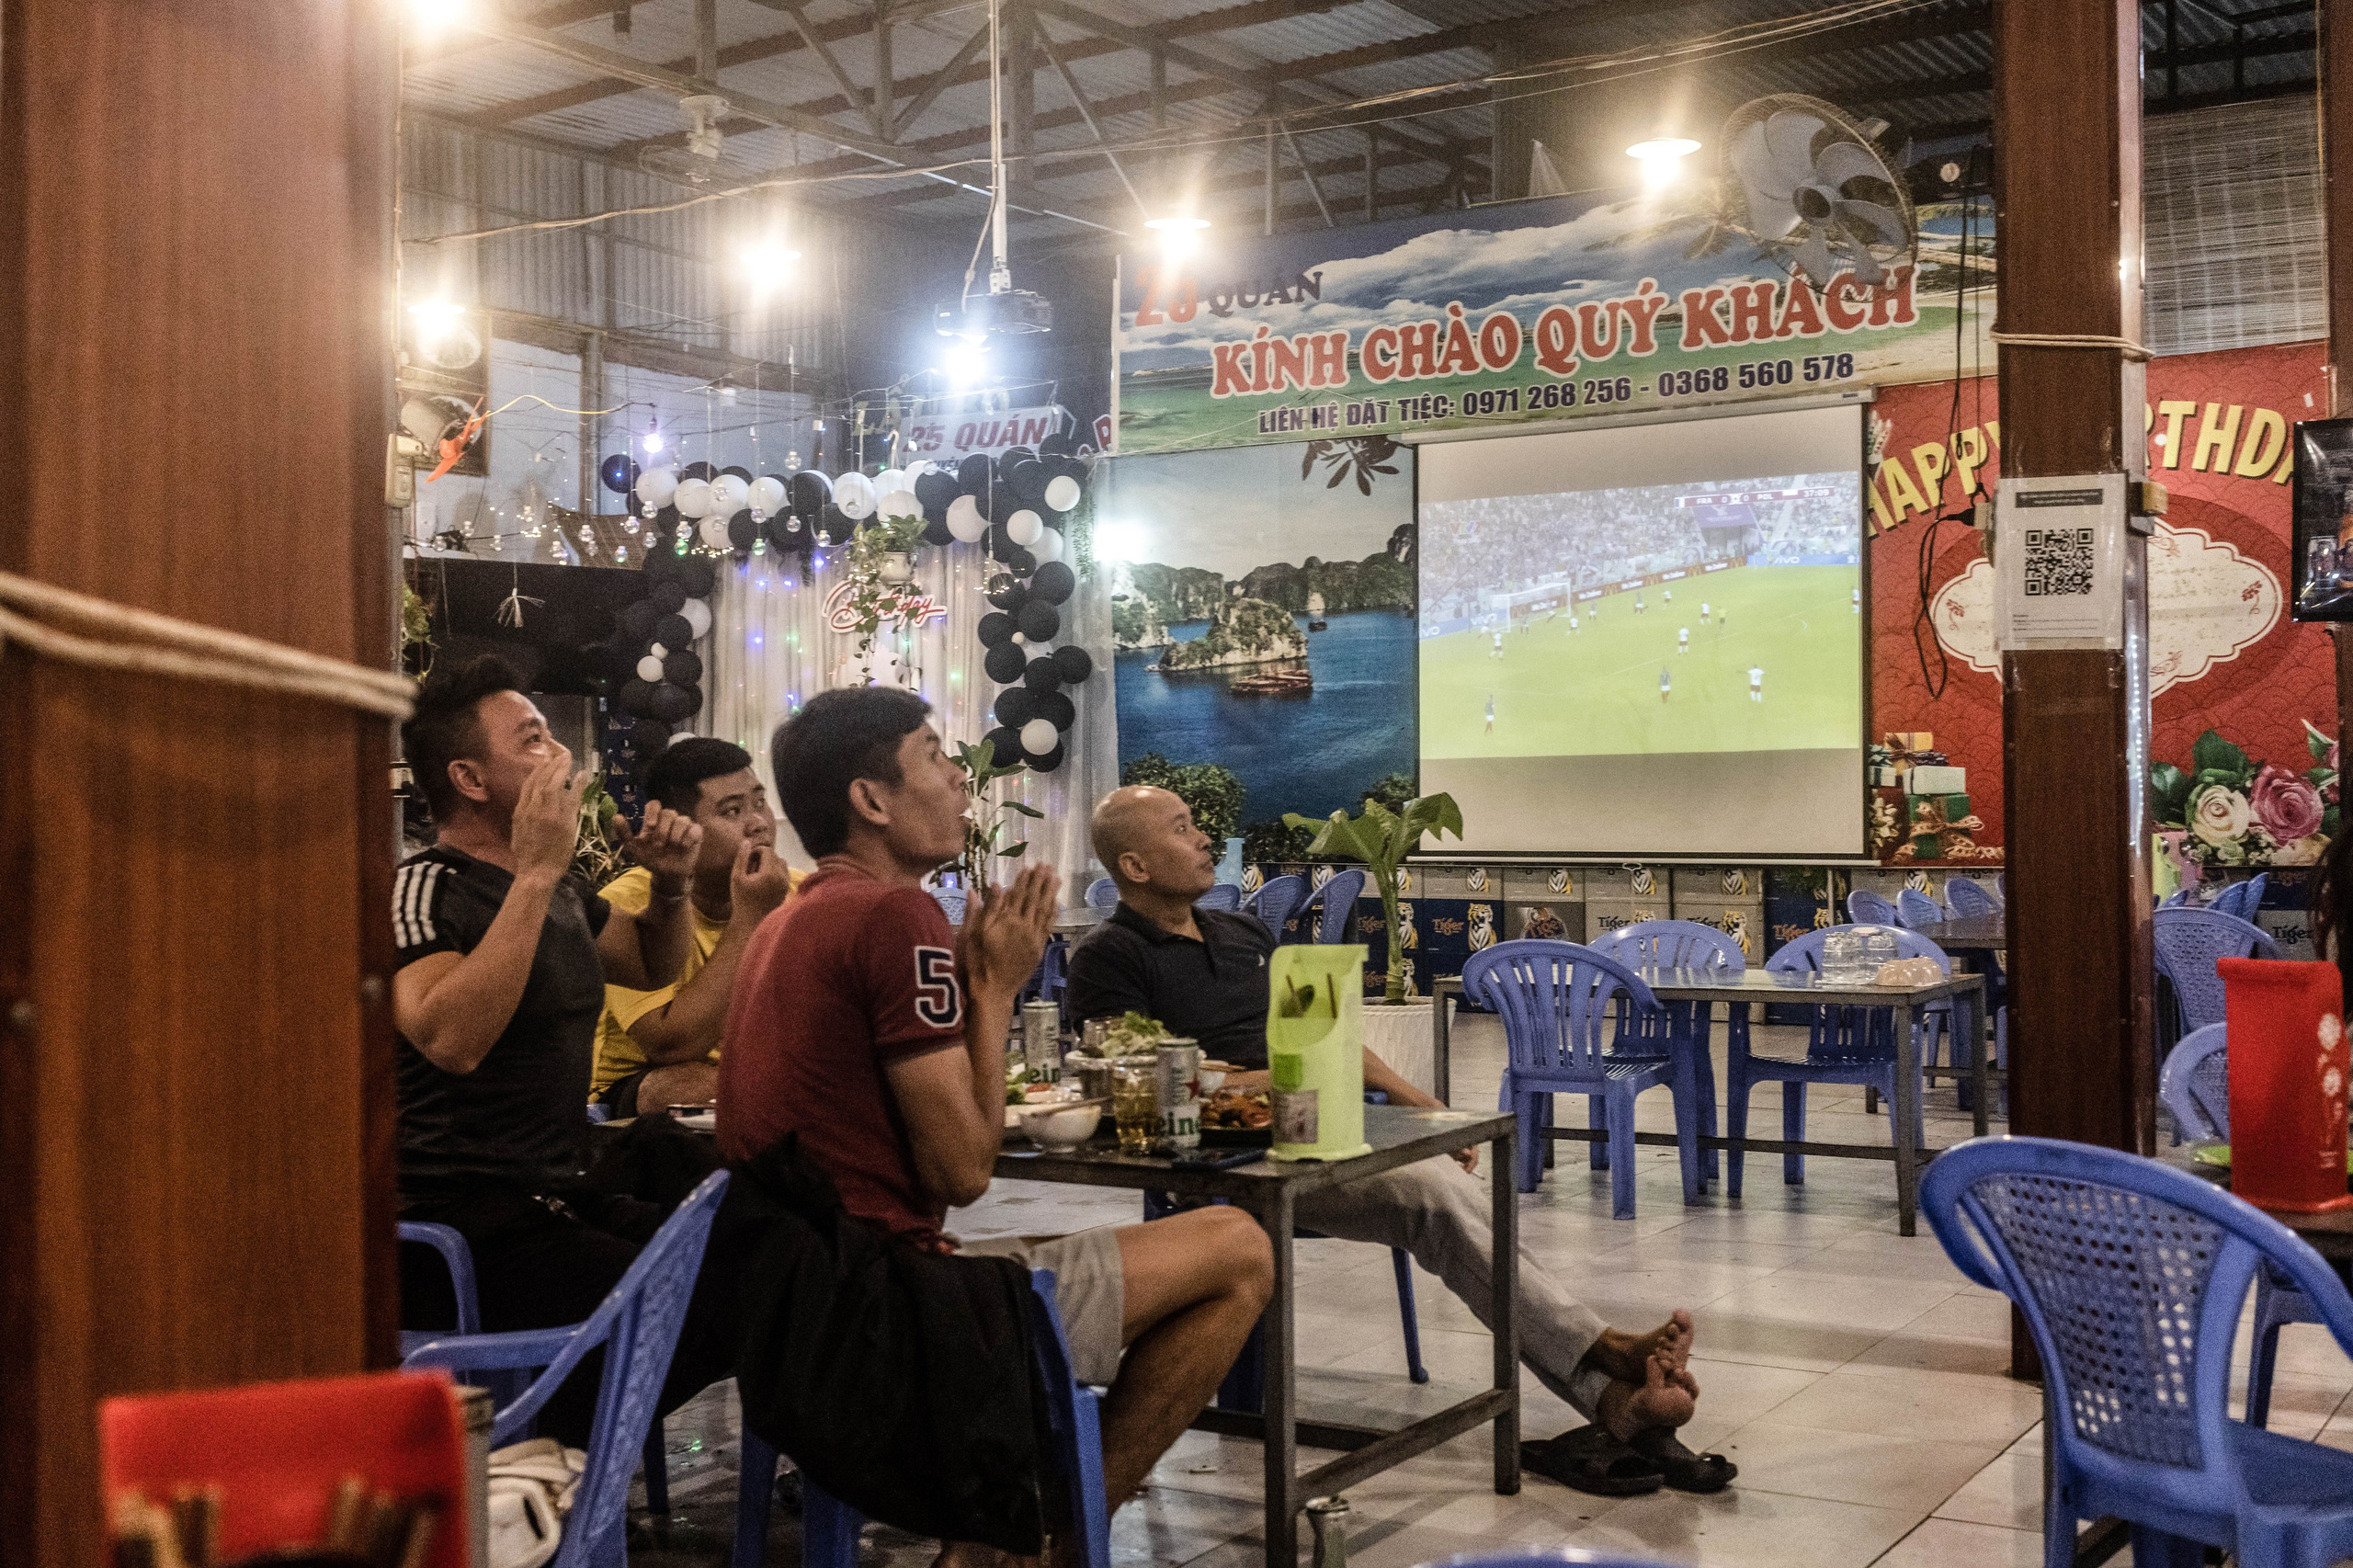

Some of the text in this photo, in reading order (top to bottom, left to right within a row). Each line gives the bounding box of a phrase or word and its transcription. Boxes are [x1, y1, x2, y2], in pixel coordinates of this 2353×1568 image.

[1212, 263, 1917, 396] KÍNH CHÀO QUÝ KHÁCH
[1259, 403, 1303, 433] LIÊN
[1311, 402, 1339, 433] HỆ
[1346, 398, 1391, 429] ĐẶT
[1397, 392, 1456, 425] TIỆC:
[1461, 390, 1518, 416] 0971
[1527, 382, 1576, 410] 268
[1584, 377, 1631, 404] 256
[1658, 366, 1729, 397] 0368
[1739, 358, 1793, 389] 560
[1803, 352, 1855, 382] 578
[954, 415, 1048, 451] QUÁN
[1868, 401, 2293, 537] HAPP THD
[1696, 496, 1713, 505] FRA
[1432, 917, 1464, 936] Tiger
[1772, 924, 1810, 943] Tiger
[915, 945, 961, 1028] 5
